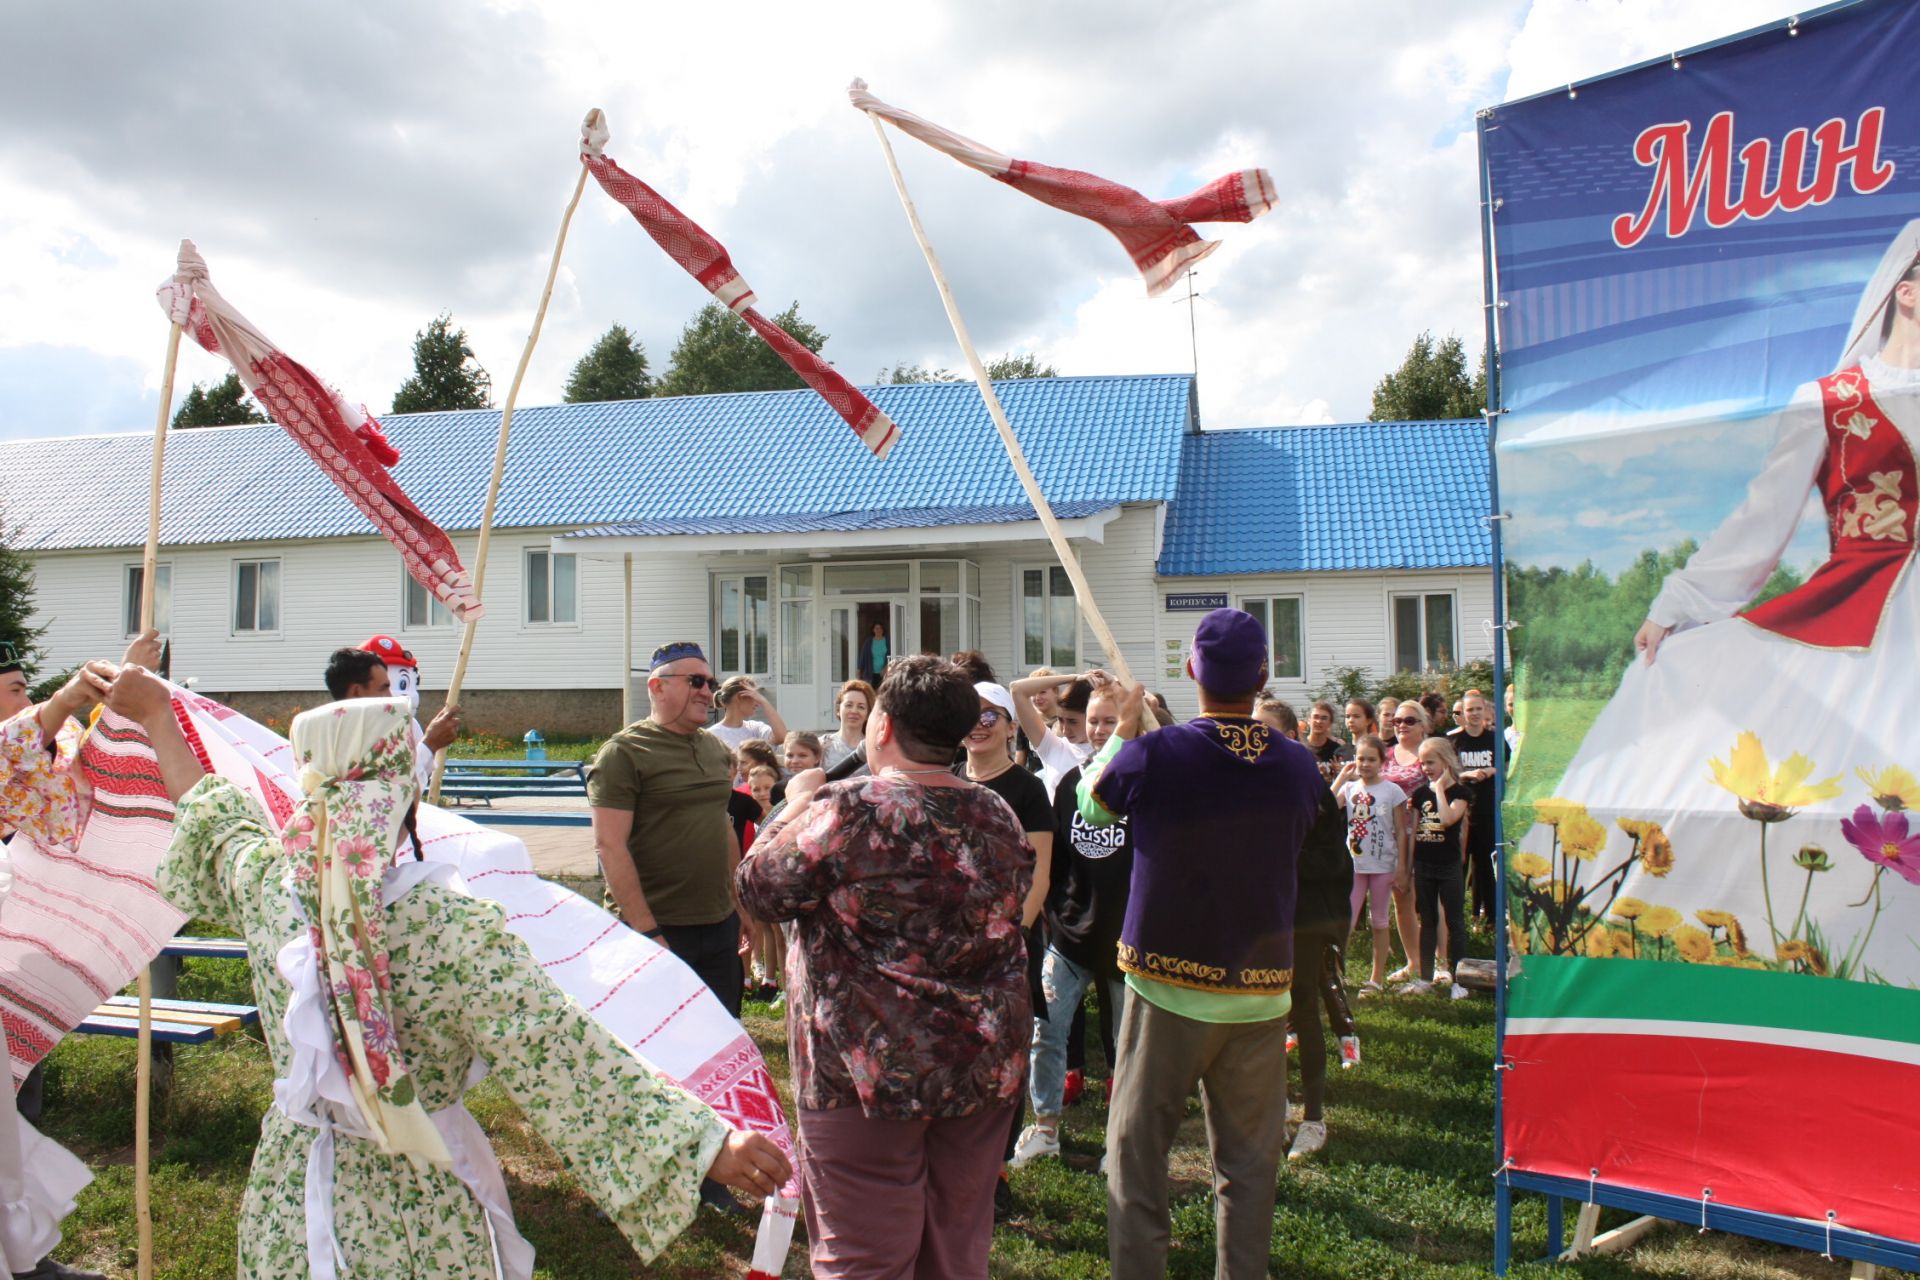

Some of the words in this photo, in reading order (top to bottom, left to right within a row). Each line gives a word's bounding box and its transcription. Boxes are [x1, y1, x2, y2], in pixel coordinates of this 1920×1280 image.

[1611, 106, 1895, 249] Мин
[1170, 598, 1207, 606] КОРПУС
[1460, 750, 1493, 767] DANCE
[1070, 825, 1126, 848] Russia
